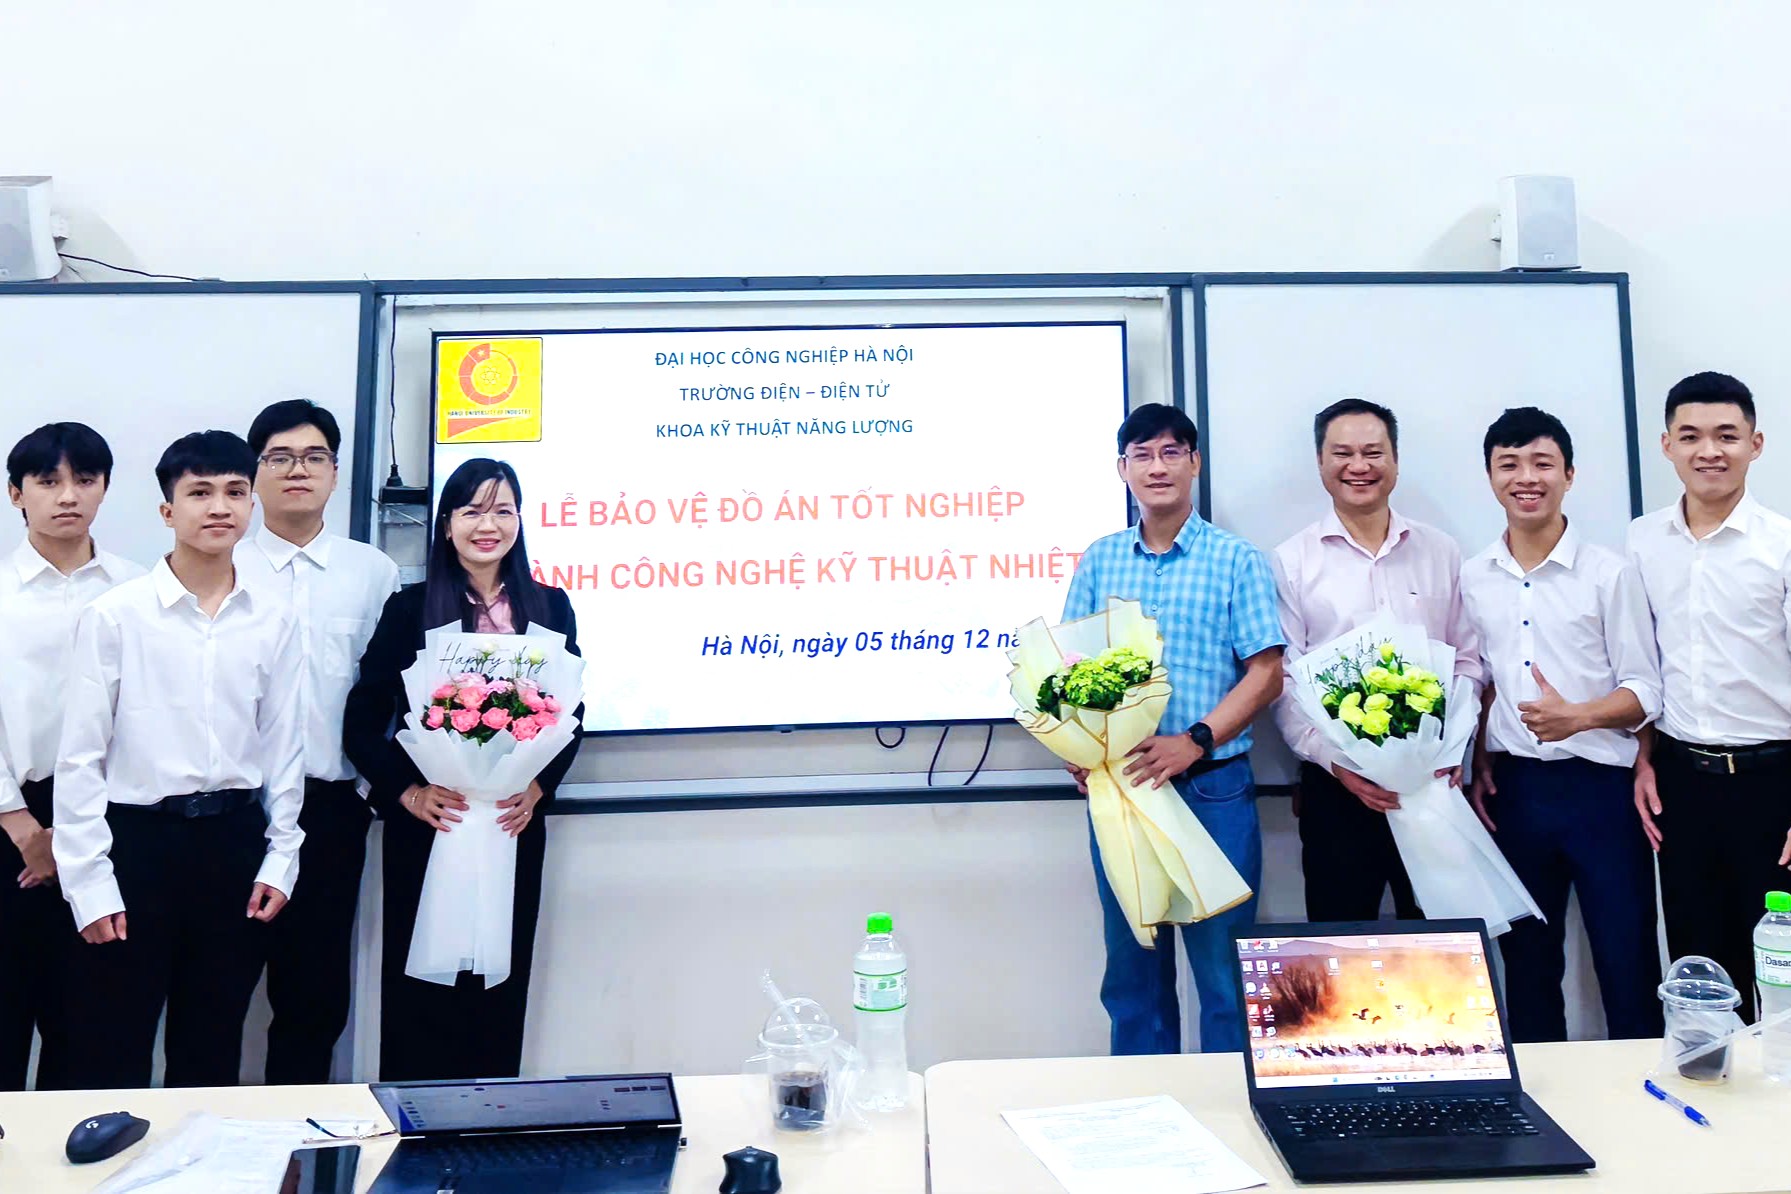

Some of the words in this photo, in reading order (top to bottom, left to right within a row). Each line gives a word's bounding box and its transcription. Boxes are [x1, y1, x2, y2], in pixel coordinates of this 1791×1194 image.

[655, 351, 684, 368] ĐẠI
[690, 350, 725, 368] HỌC
[731, 347, 779, 364] CÔNG
[786, 345, 849, 366] NGHIỆP
[854, 345, 878, 362] HÀ
[883, 344, 913, 365] NỘI
[679, 384, 754, 401] TRƯỜNG
[761, 382, 800, 402] ĐIỆN
[820, 382, 859, 401] ĐIỆN
[865, 379, 891, 398] TỬ
[656, 424, 704, 438] KHOA
[710, 420, 731, 437] KỸ
[736, 419, 790, 439] THUẬT
[796, 418, 846, 435] NĂNG
[852, 420, 913, 437] LƯỢNG
[541, 492, 577, 527] LỄ
[589, 492, 656, 526] BẢO
[668, 492, 708, 529] VỆ
[717, 489, 763, 523] ĐỒ
[774, 490, 819, 521] ÁN
[830, 486, 894, 520] TỐT
[906, 485, 1025, 523] NGHIỆP
[531, 560, 598, 590] ÀNH
[610, 556, 704, 590] CÔNG
[716, 552, 806, 590] NGHỆ
[817, 551, 857, 583] KỸ
[868, 549, 978, 586] THUẬT
[990, 546, 1085, 584] NHIỆT
[702, 634, 732, 656] Hà
[740, 633, 784, 659] Nội,
[792, 631, 848, 658] ngày
[855, 631, 883, 652] 05
[890, 629, 955, 655] tháng
[965, 628, 990, 649] 12
